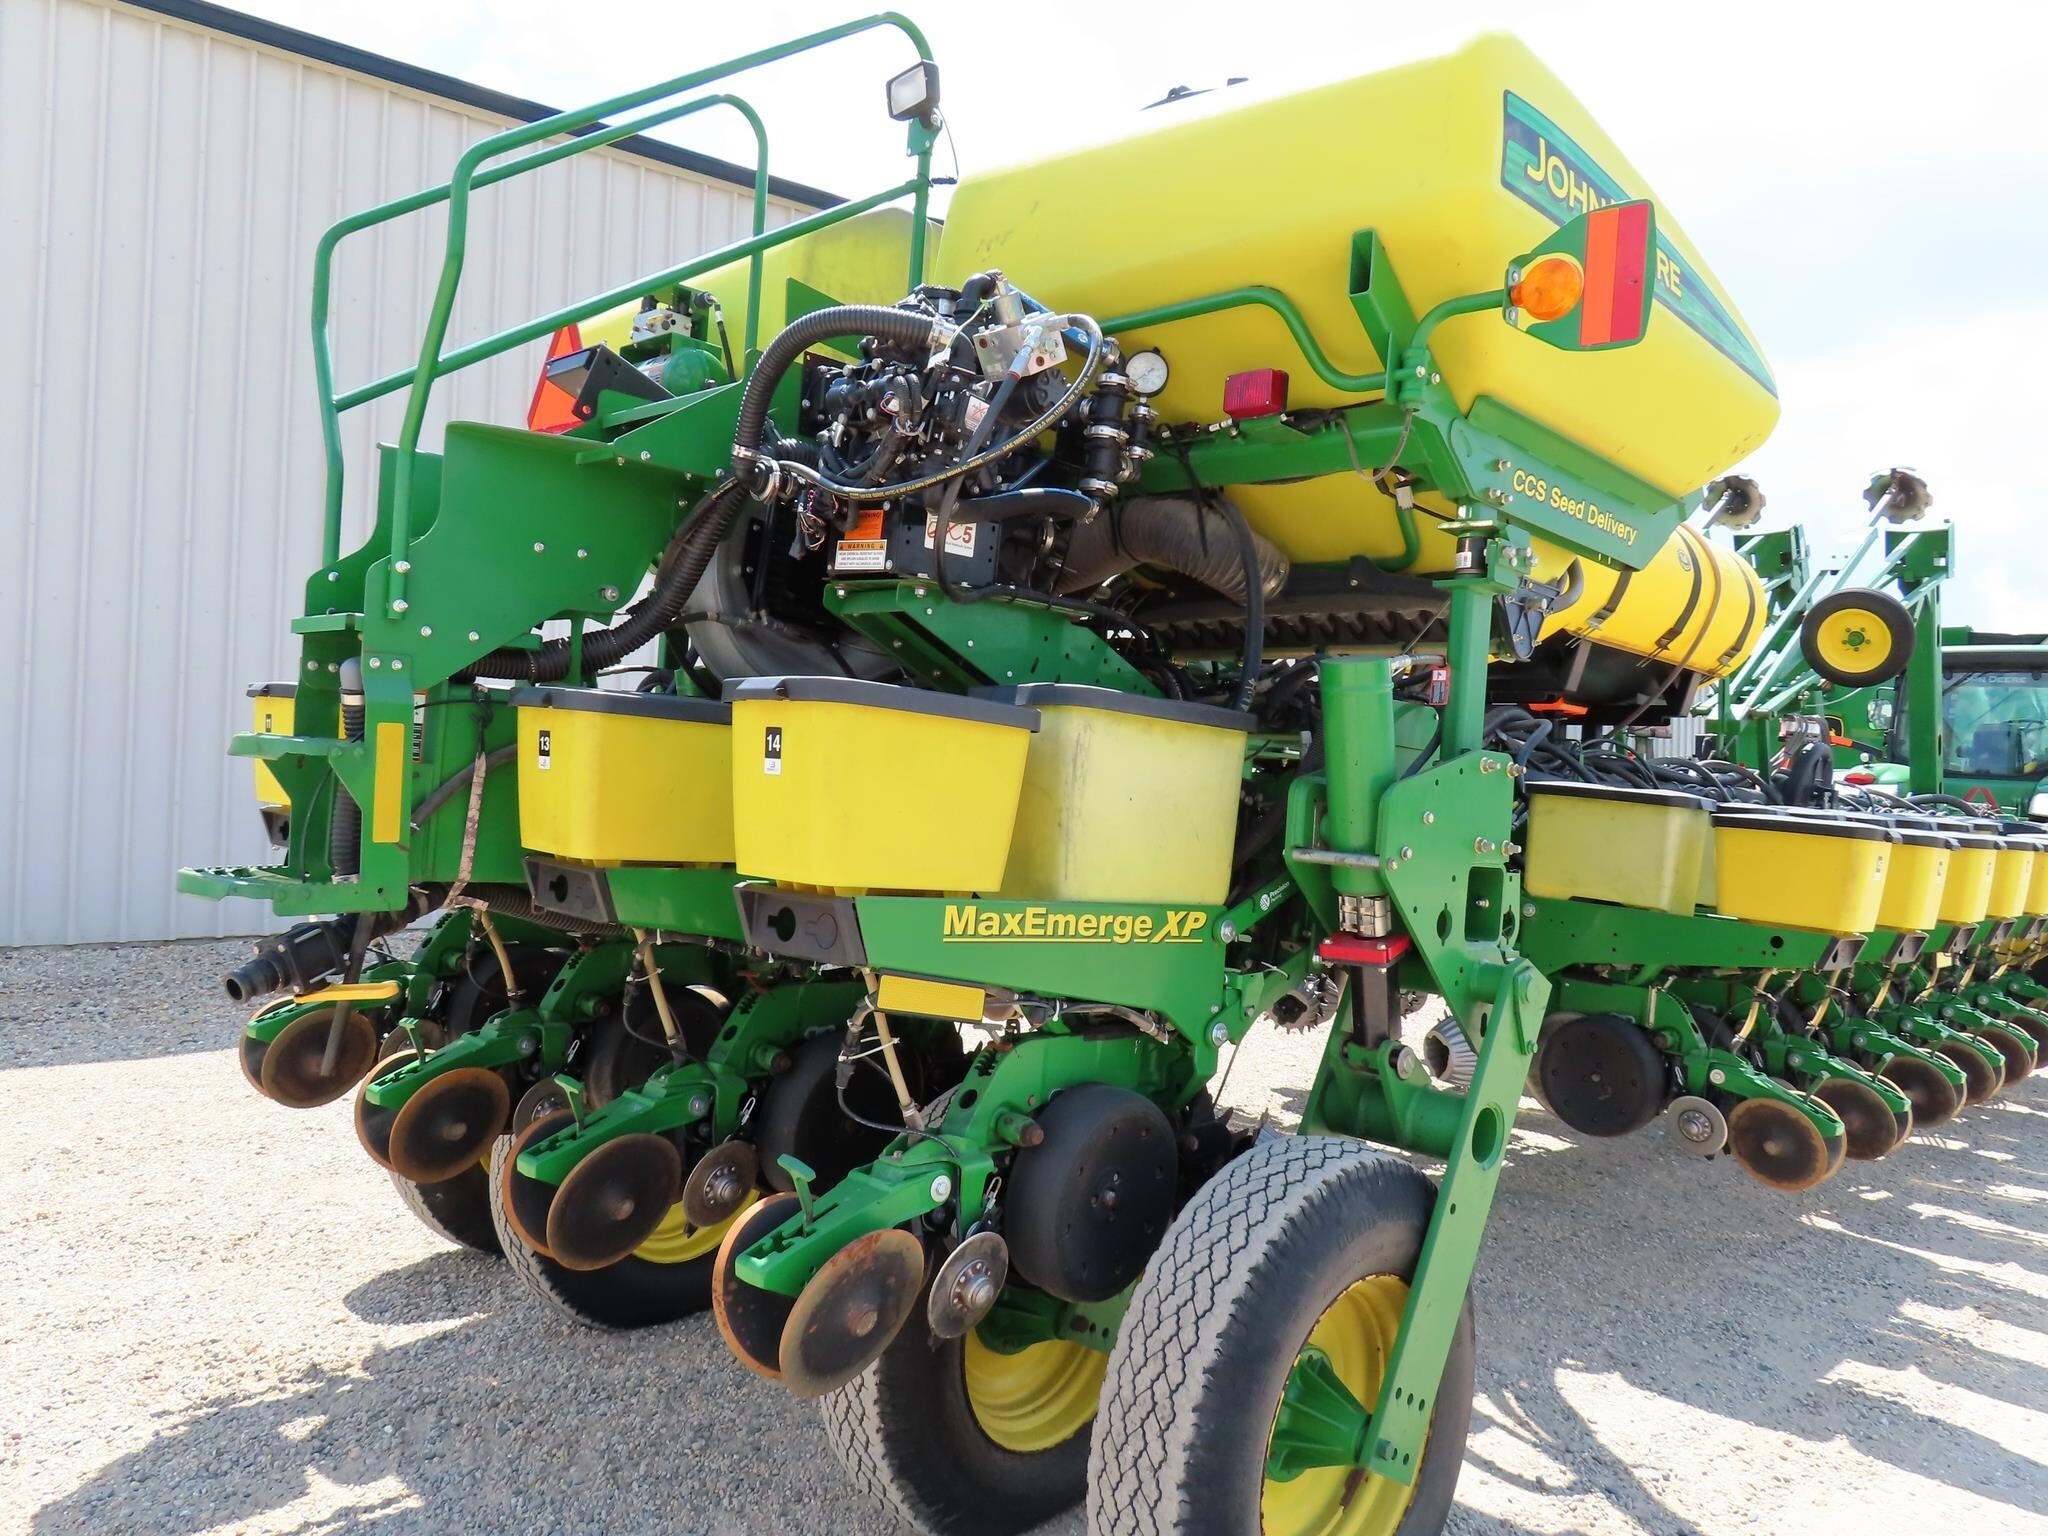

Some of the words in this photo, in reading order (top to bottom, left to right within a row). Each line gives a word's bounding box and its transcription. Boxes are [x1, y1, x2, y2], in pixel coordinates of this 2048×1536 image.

[1513, 469, 1547, 502] CCS
[1550, 486, 1585, 520] Seed
[1587, 503, 1638, 547] Delivery
[847, 542, 876, 550] WARNING
[539, 736, 550, 751] 13
[766, 734, 781, 752] 14
[943, 904, 1153, 944] MaxEmerge
[1150, 911, 1207, 943] XP
